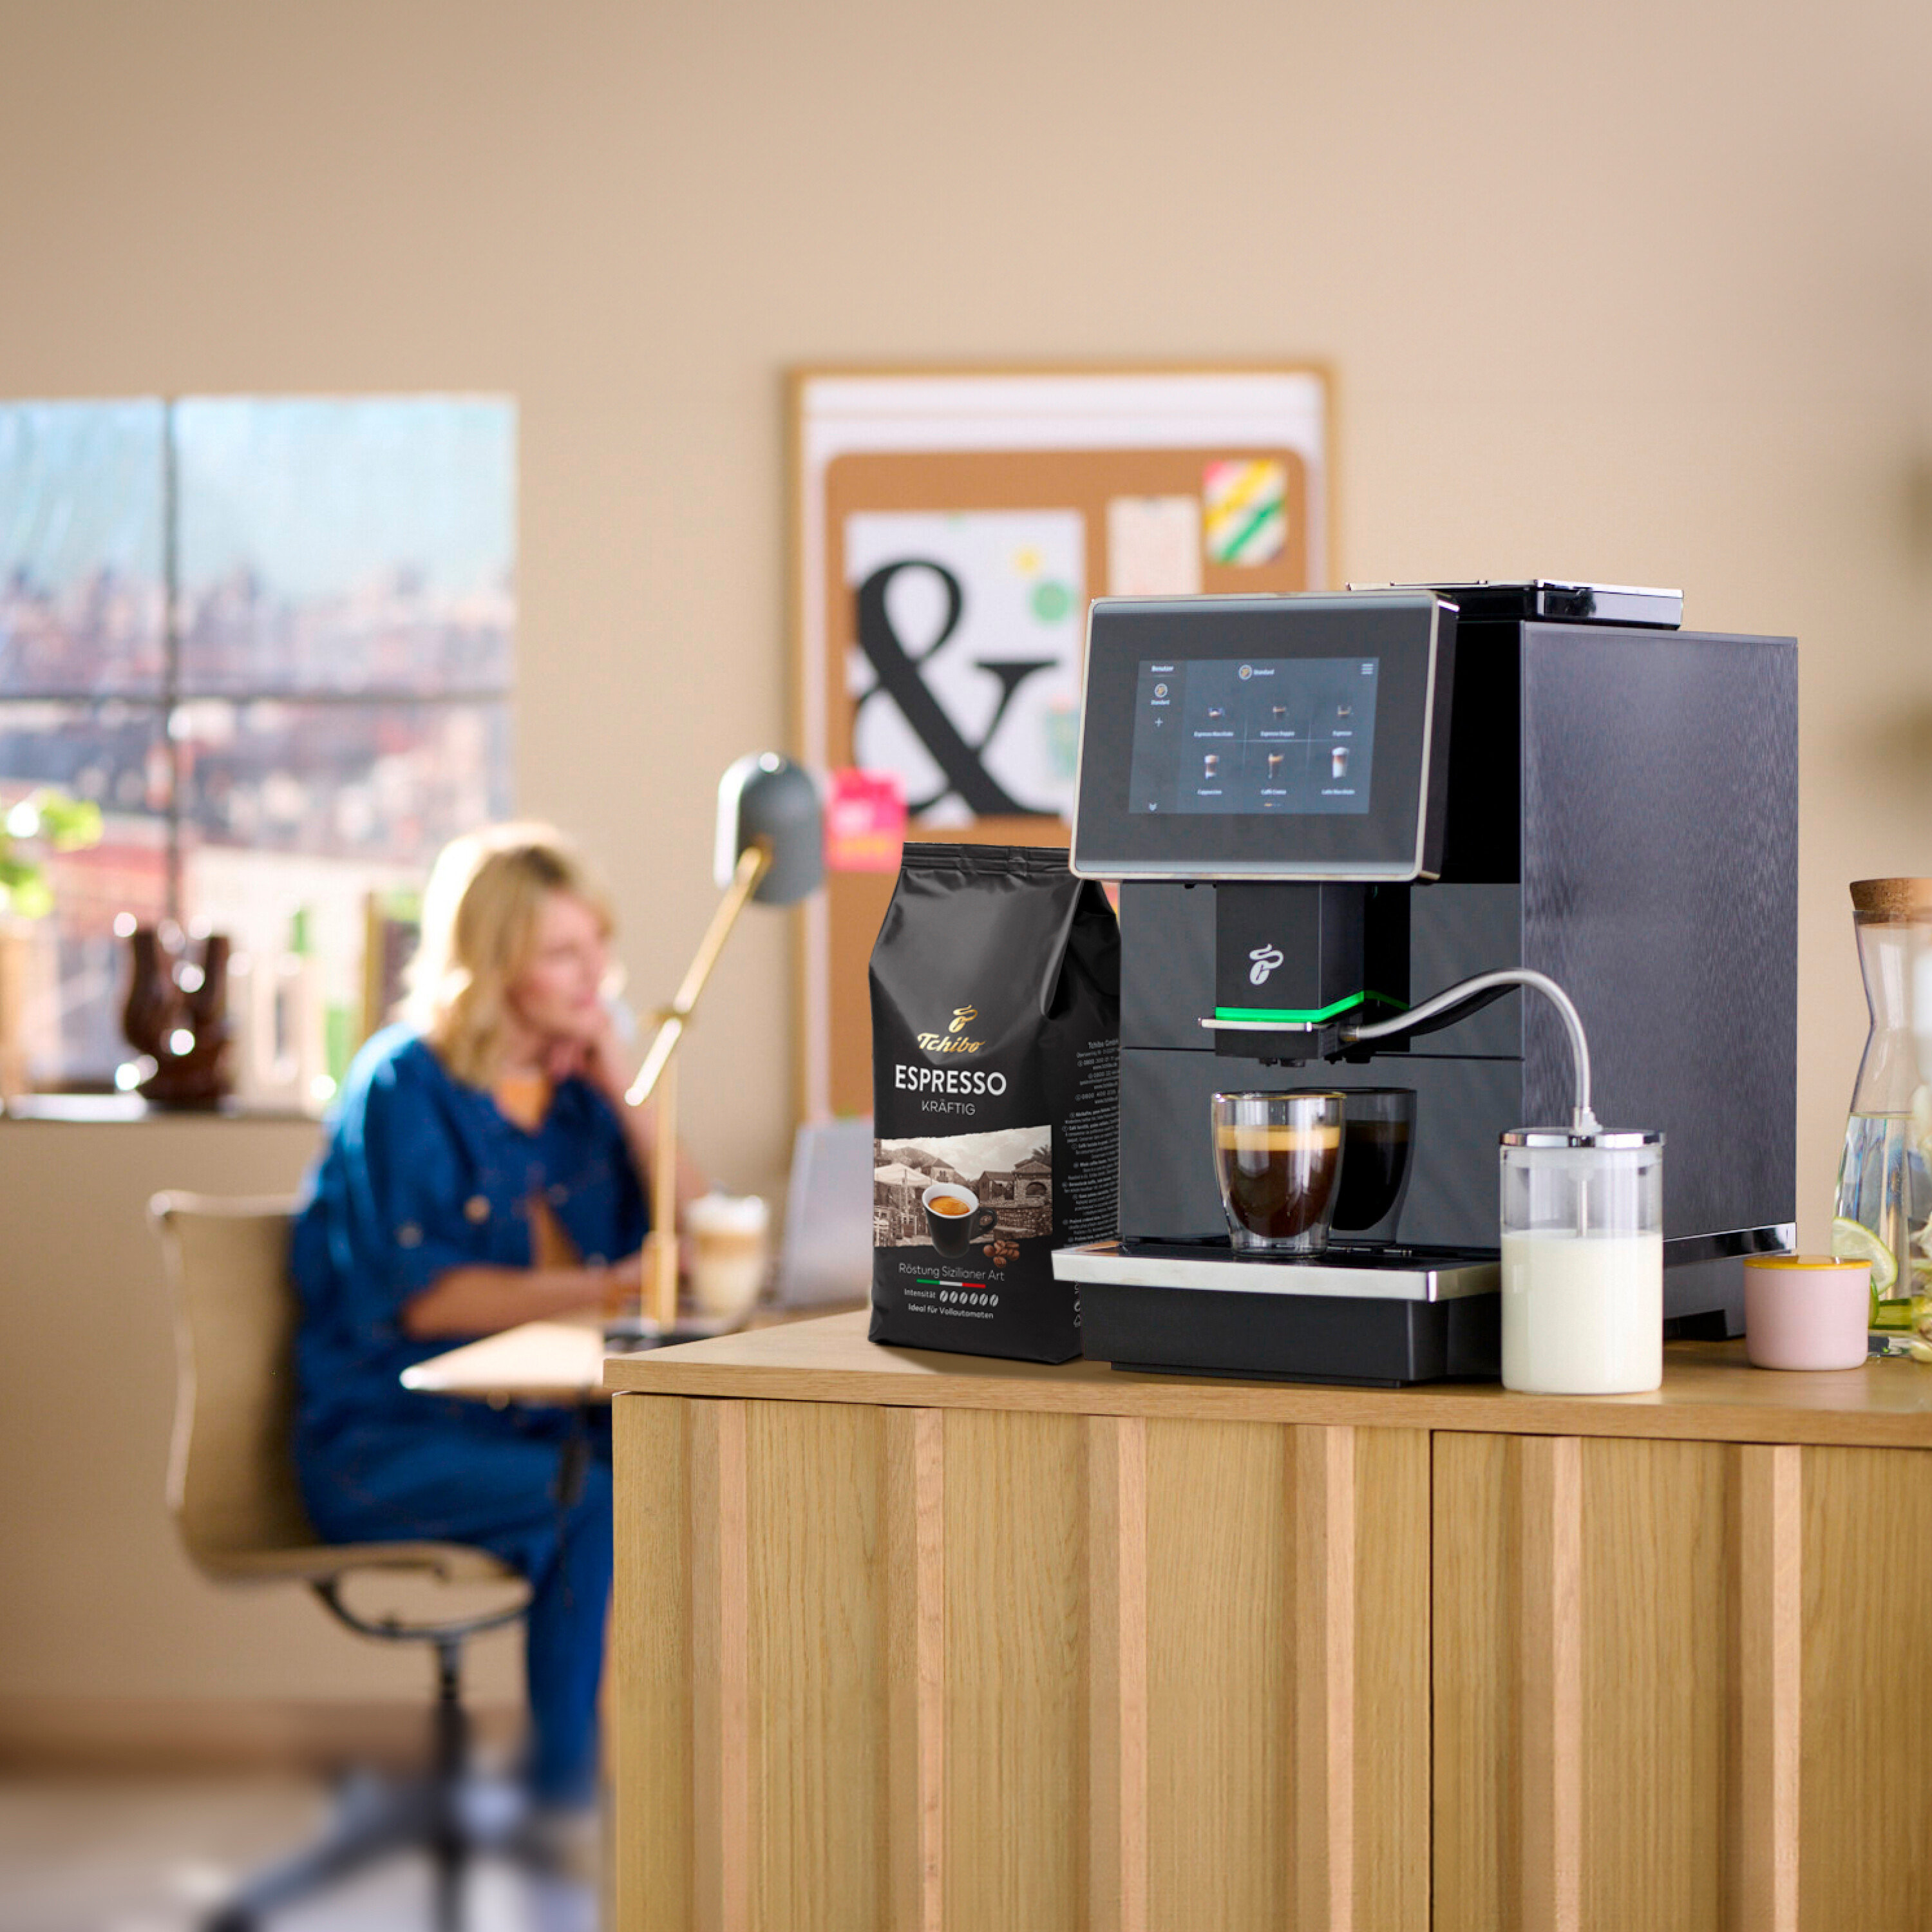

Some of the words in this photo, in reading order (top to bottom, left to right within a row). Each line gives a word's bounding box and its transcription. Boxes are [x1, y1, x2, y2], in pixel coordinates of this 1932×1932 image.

[917, 1032, 985, 1054] Tchibo
[895, 1063, 1007, 1096] ESPRESSO
[921, 1098, 976, 1115] KRÄFTIG
[898, 1262, 940, 1278] Röstung
[942, 1265, 987, 1280] Sizilianer
[988, 1269, 1005, 1282] Art
[908, 1303, 926, 1312] Ideal
[927, 1305, 938, 1314] für
[939, 1307, 994, 1319] Vollautomaten
